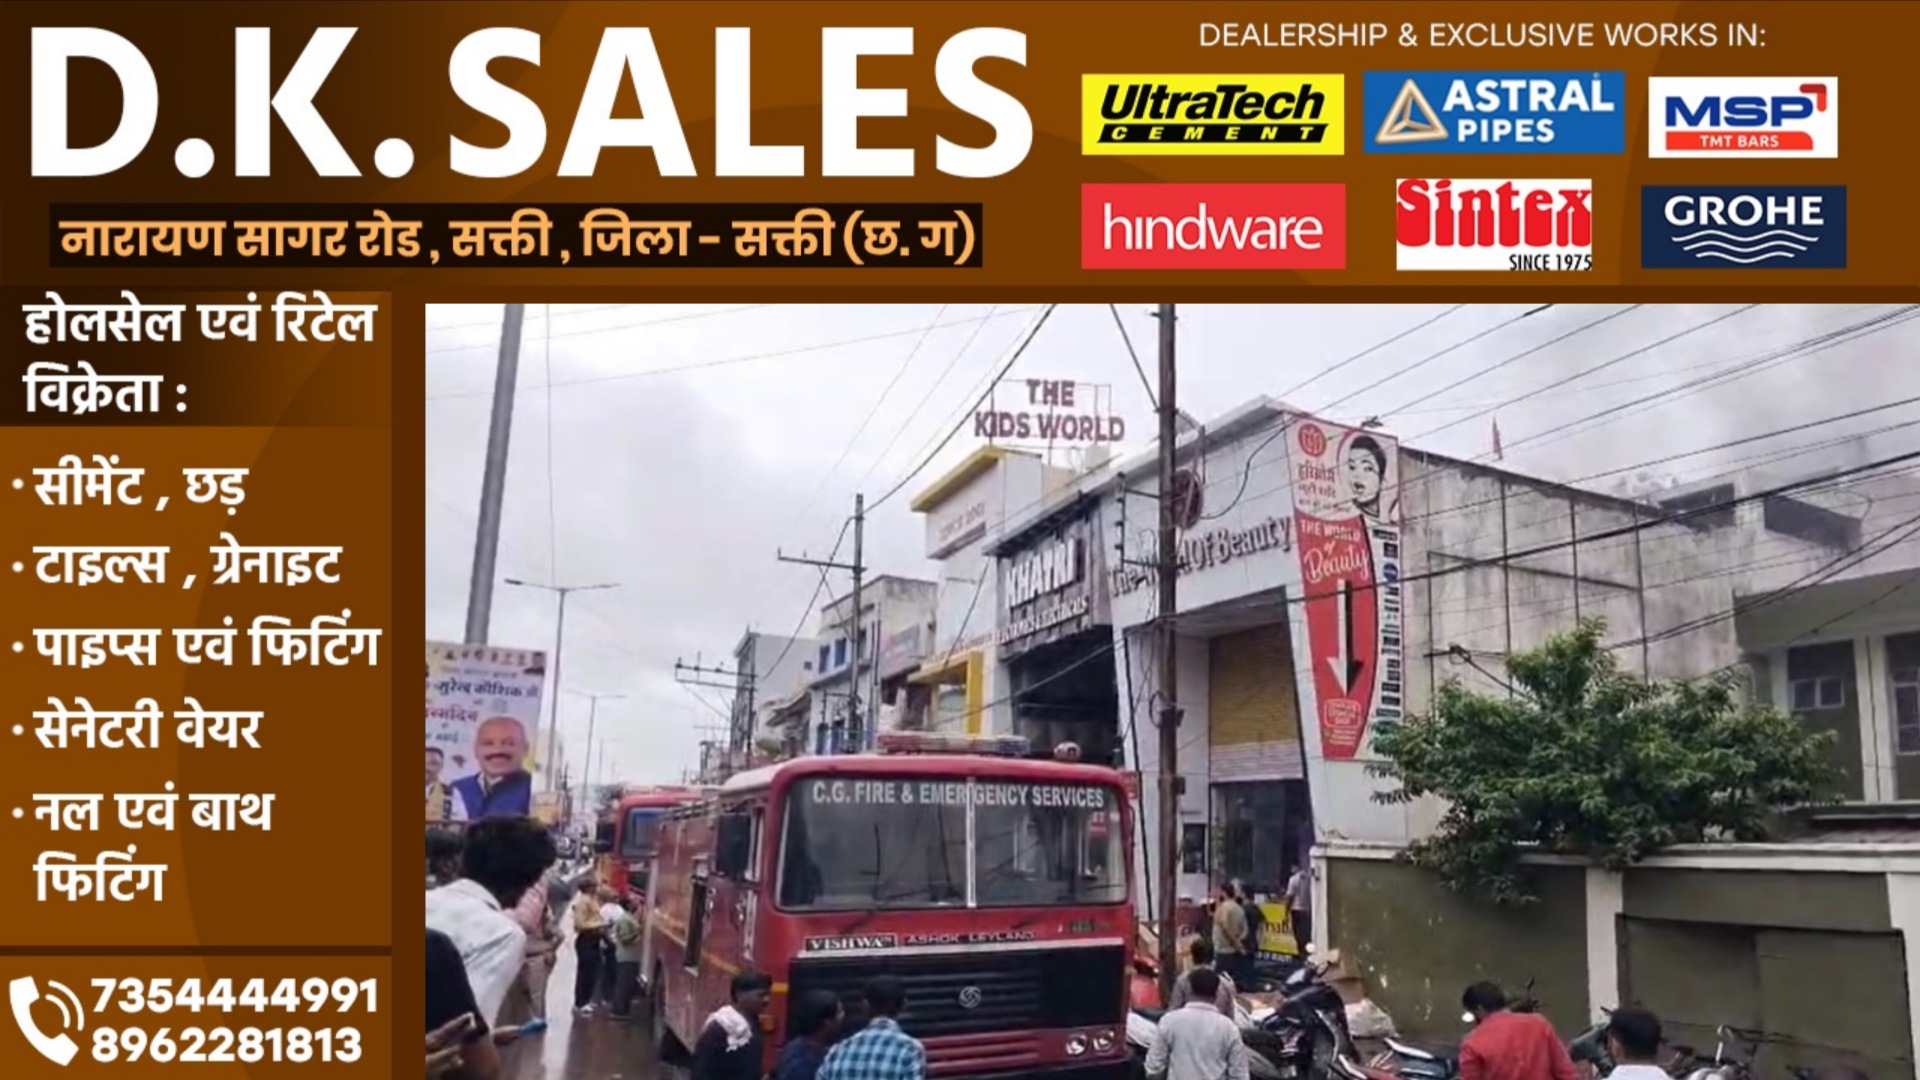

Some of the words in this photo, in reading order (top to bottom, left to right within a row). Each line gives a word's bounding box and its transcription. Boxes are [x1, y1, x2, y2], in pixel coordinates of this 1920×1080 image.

[1026, 378, 1075, 406] THE
[975, 411, 1031, 439] KIDS
[1037, 413, 1125, 442] WORLD
[1301, 519, 1320, 536] THE
[1303, 544, 1370, 584] Beauty
[812, 780, 850, 803] C.G.
[854, 782, 896, 804] FIRE
[901, 783, 913, 803] &
[1031, 786, 1105, 808] SERVICES
[908, 933, 960, 945] ASHOK
